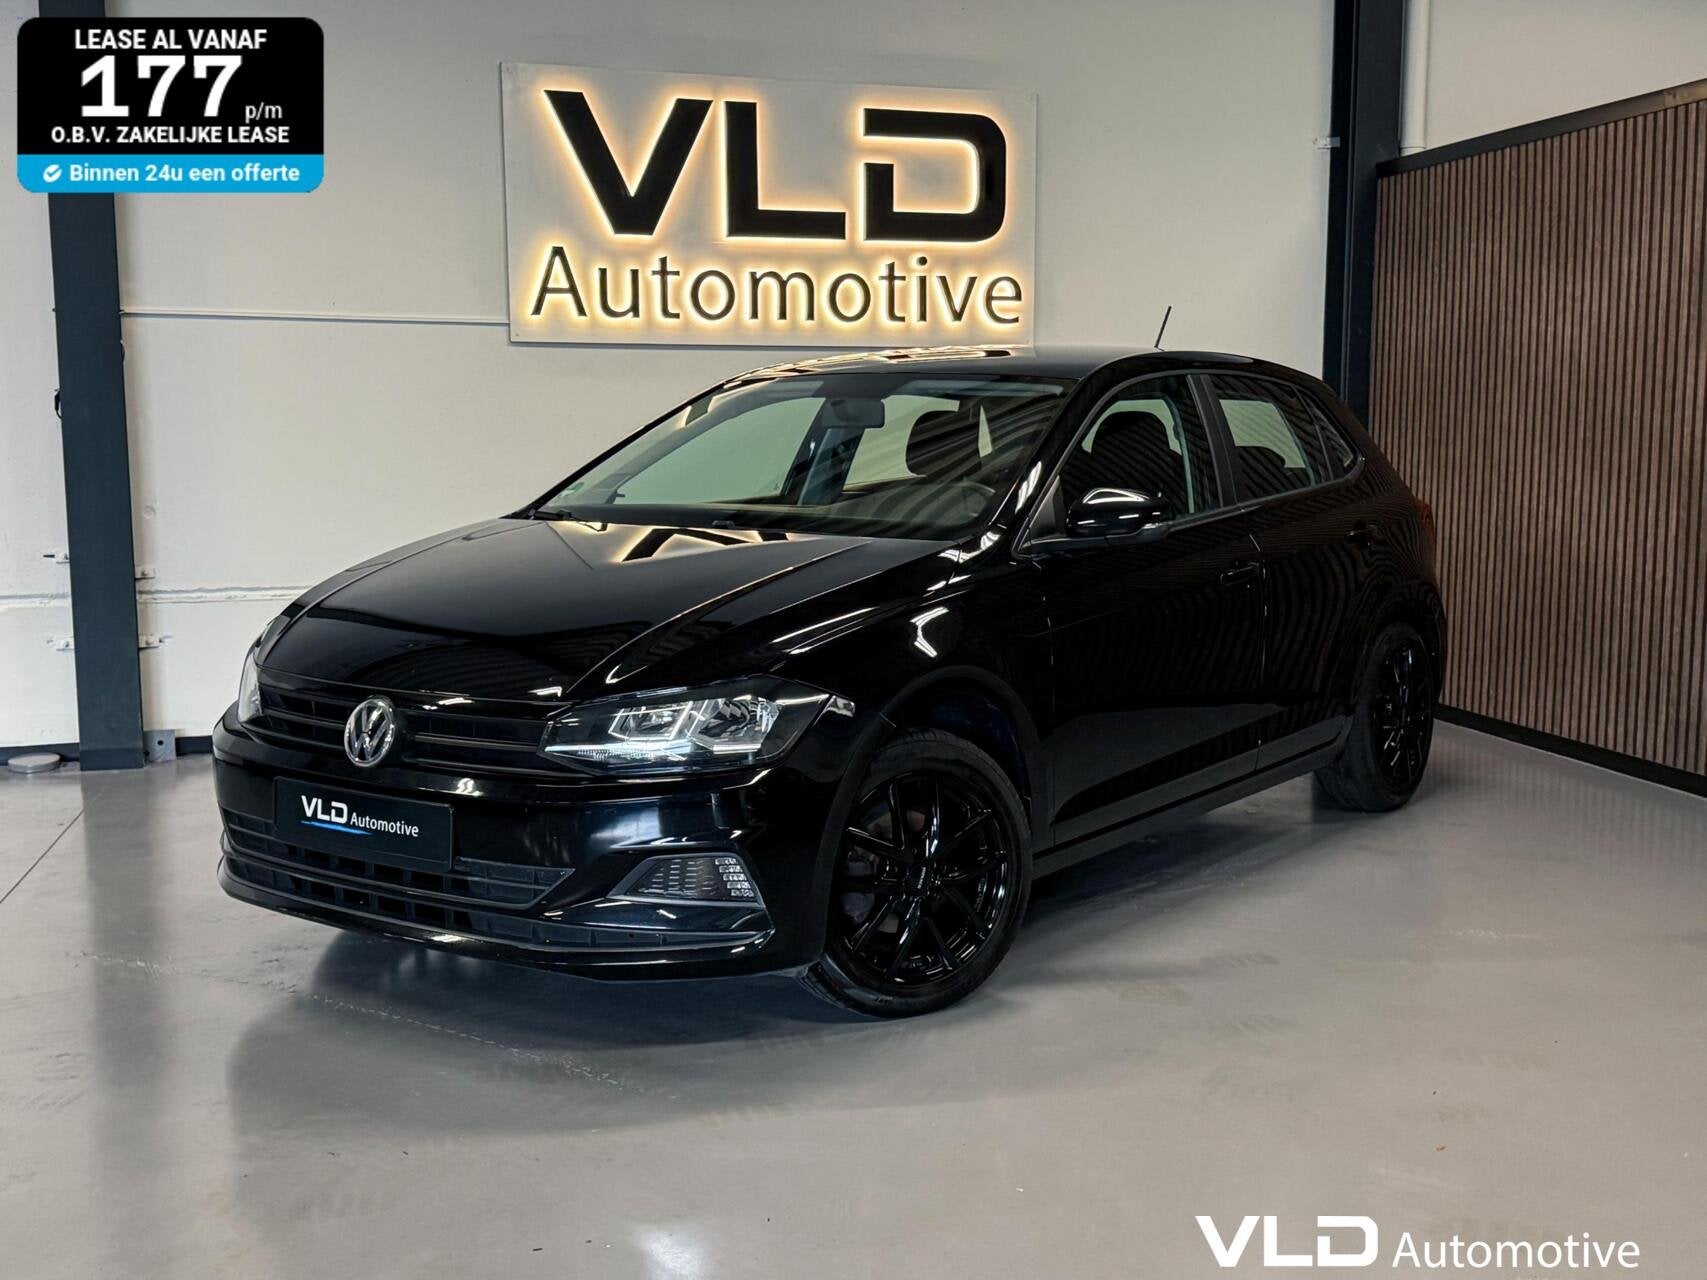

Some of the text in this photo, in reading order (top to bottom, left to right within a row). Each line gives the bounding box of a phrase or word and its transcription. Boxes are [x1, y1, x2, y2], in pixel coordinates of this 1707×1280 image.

[543, 89, 1006, 242] VLD
[530, 246, 1022, 323] Automotive
[301, 795, 419, 838] VLD Automotive
